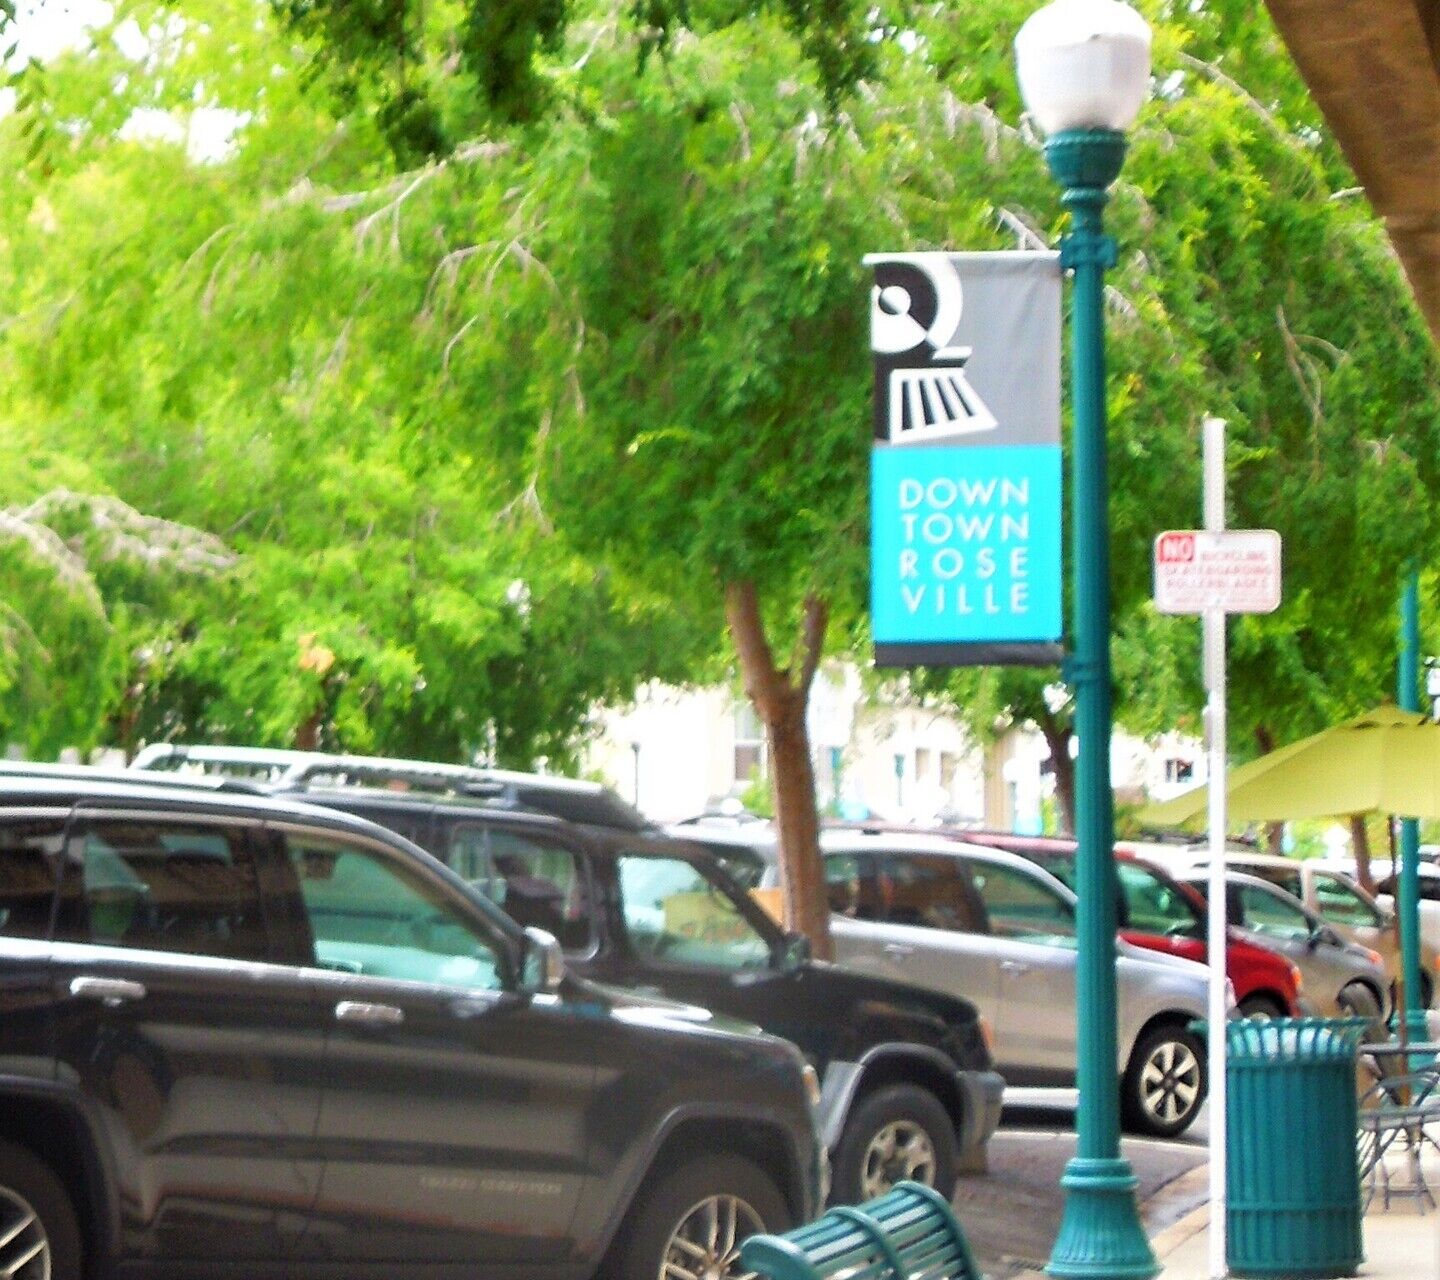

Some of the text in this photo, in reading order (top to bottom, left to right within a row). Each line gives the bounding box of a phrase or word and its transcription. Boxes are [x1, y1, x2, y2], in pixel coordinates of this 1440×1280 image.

[899, 477, 1029, 509] DOWN
[901, 512, 1029, 544] TOWN
[899, 547, 1028, 579] ROSE
[1162, 537, 1193, 560] NO
[901, 583, 1028, 614] VILLE
